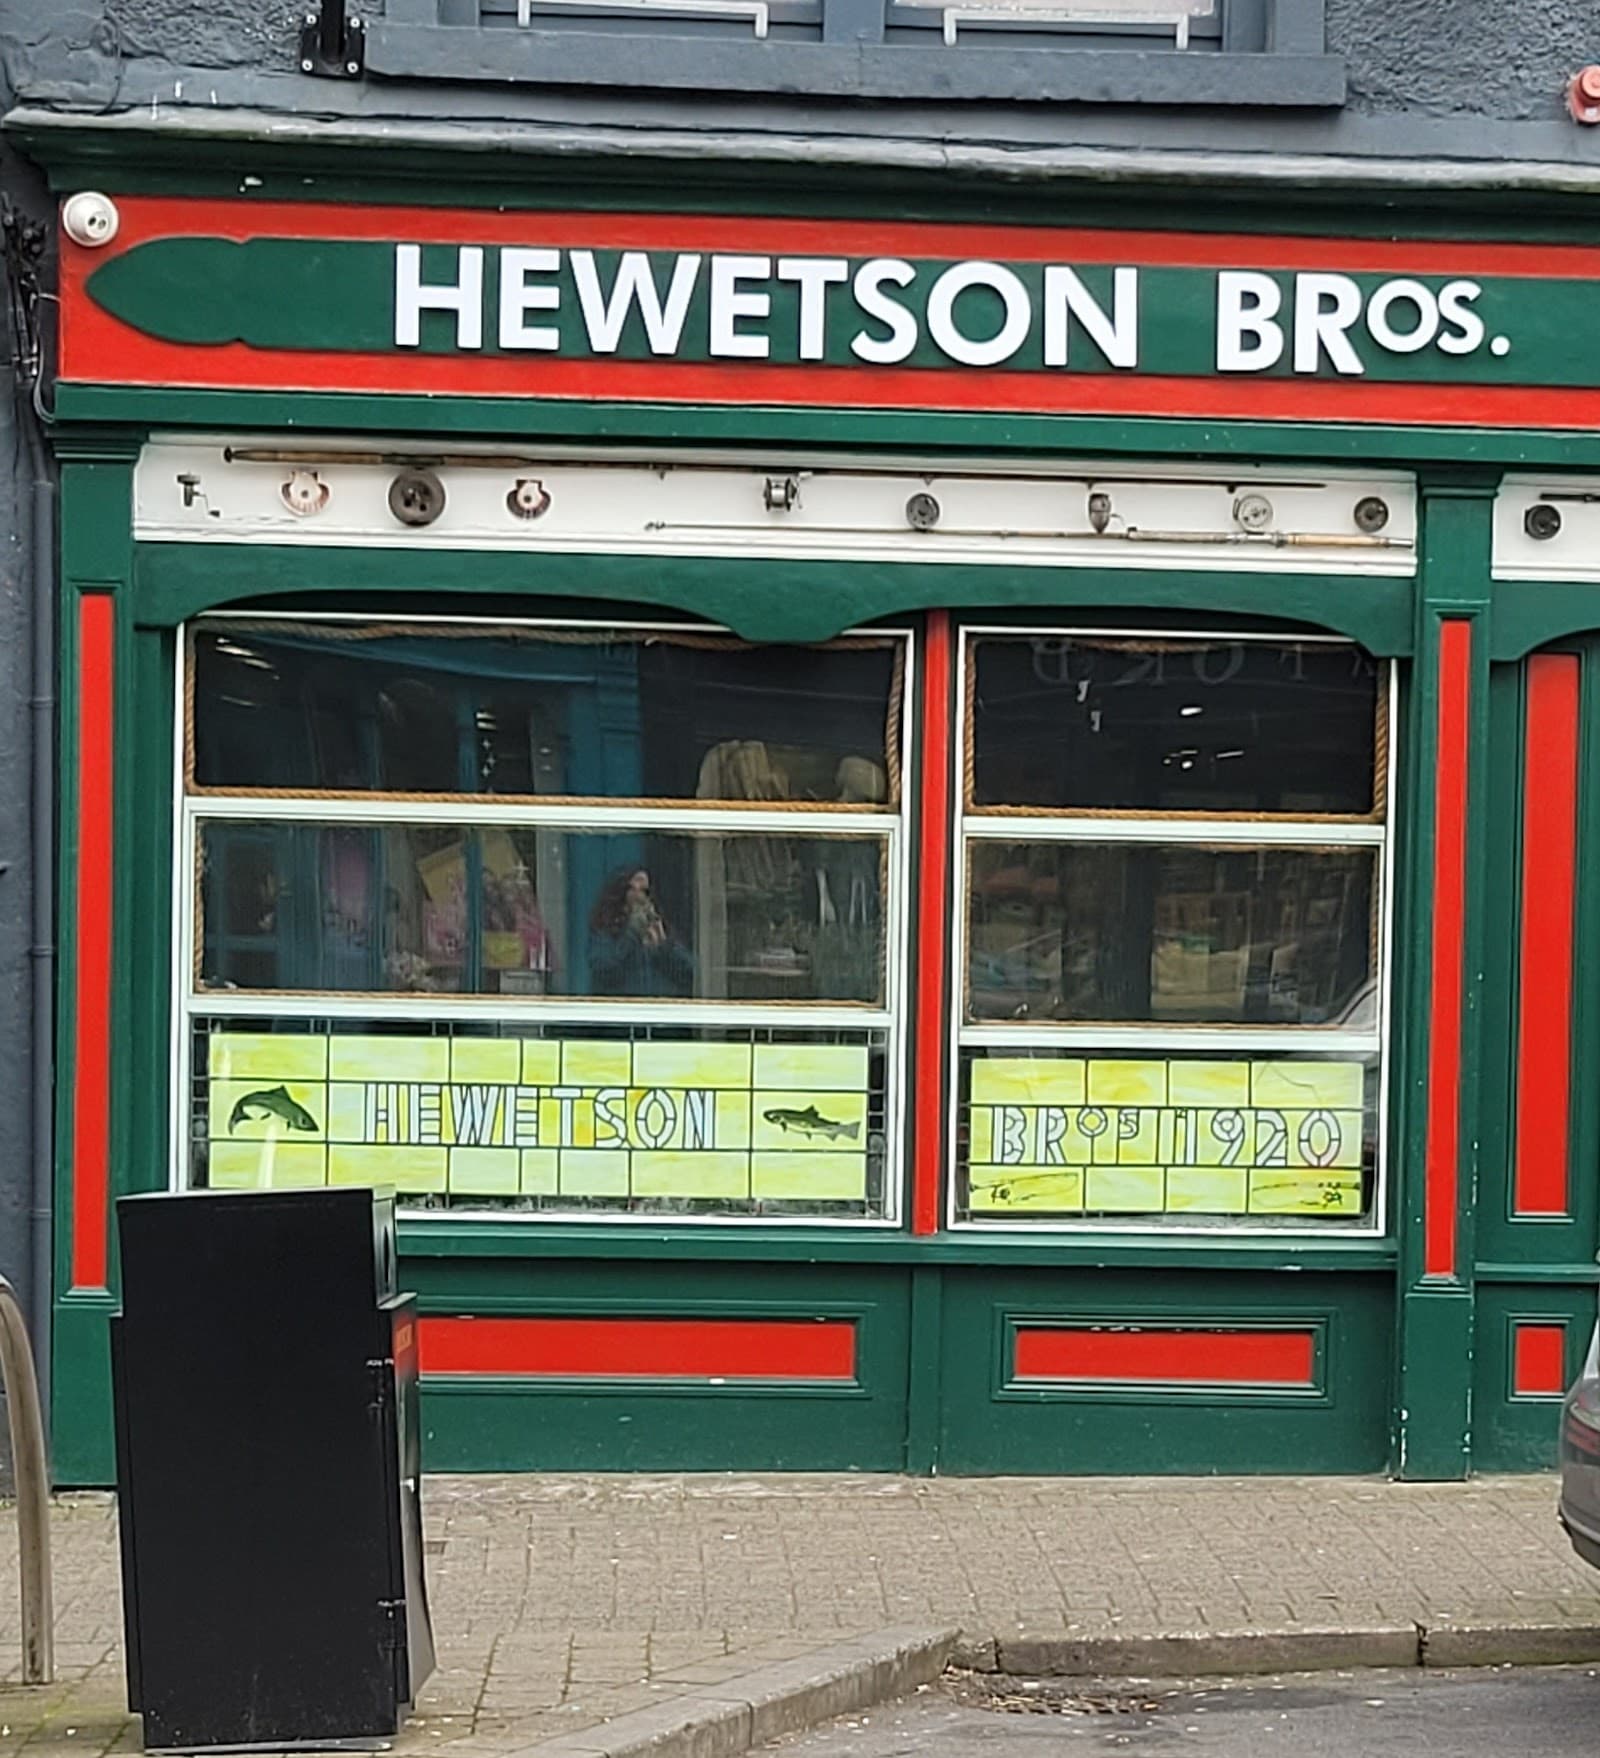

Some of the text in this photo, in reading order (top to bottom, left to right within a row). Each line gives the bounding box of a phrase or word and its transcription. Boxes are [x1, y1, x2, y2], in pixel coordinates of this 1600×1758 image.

[395, 244, 1137, 367] HEWETSON
[365, 1083, 714, 1148] HEWETSON
[1174, 1108, 1341, 1166] 1920
